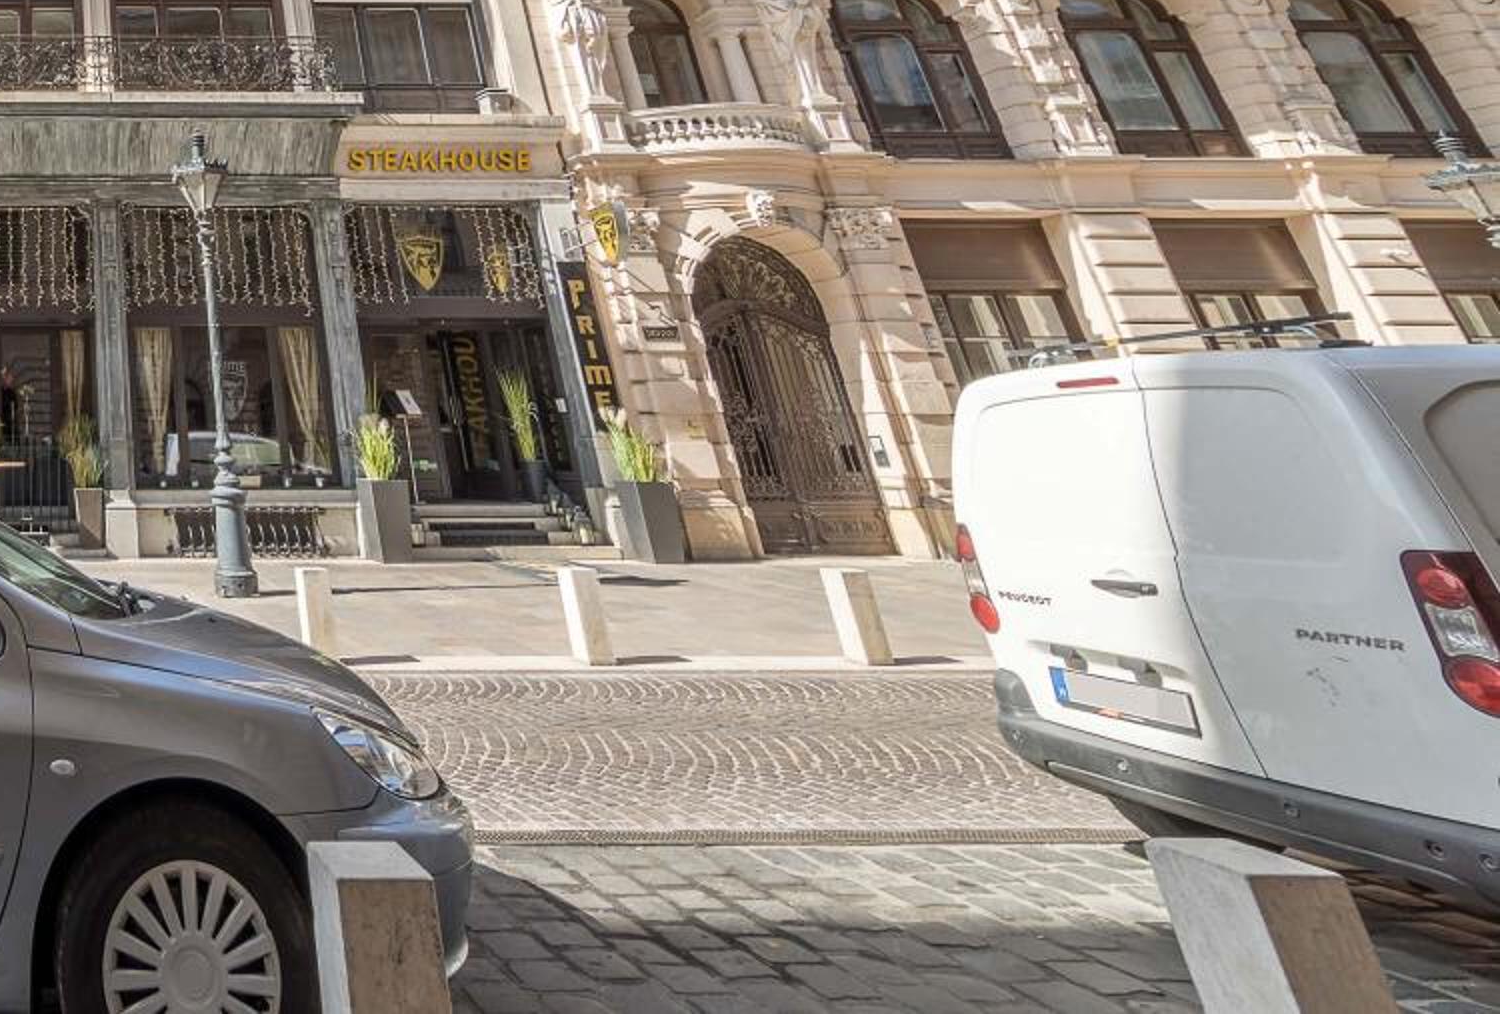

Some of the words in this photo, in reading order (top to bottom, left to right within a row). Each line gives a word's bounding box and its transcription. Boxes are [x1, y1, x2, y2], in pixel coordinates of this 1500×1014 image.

[347, 149, 532, 172] STEAKHOUSE
[567, 279, 613, 408] PRIME
[998, 591, 1052, 606] PEUGEOT
[1296, 628, 1406, 652] PARTNER
